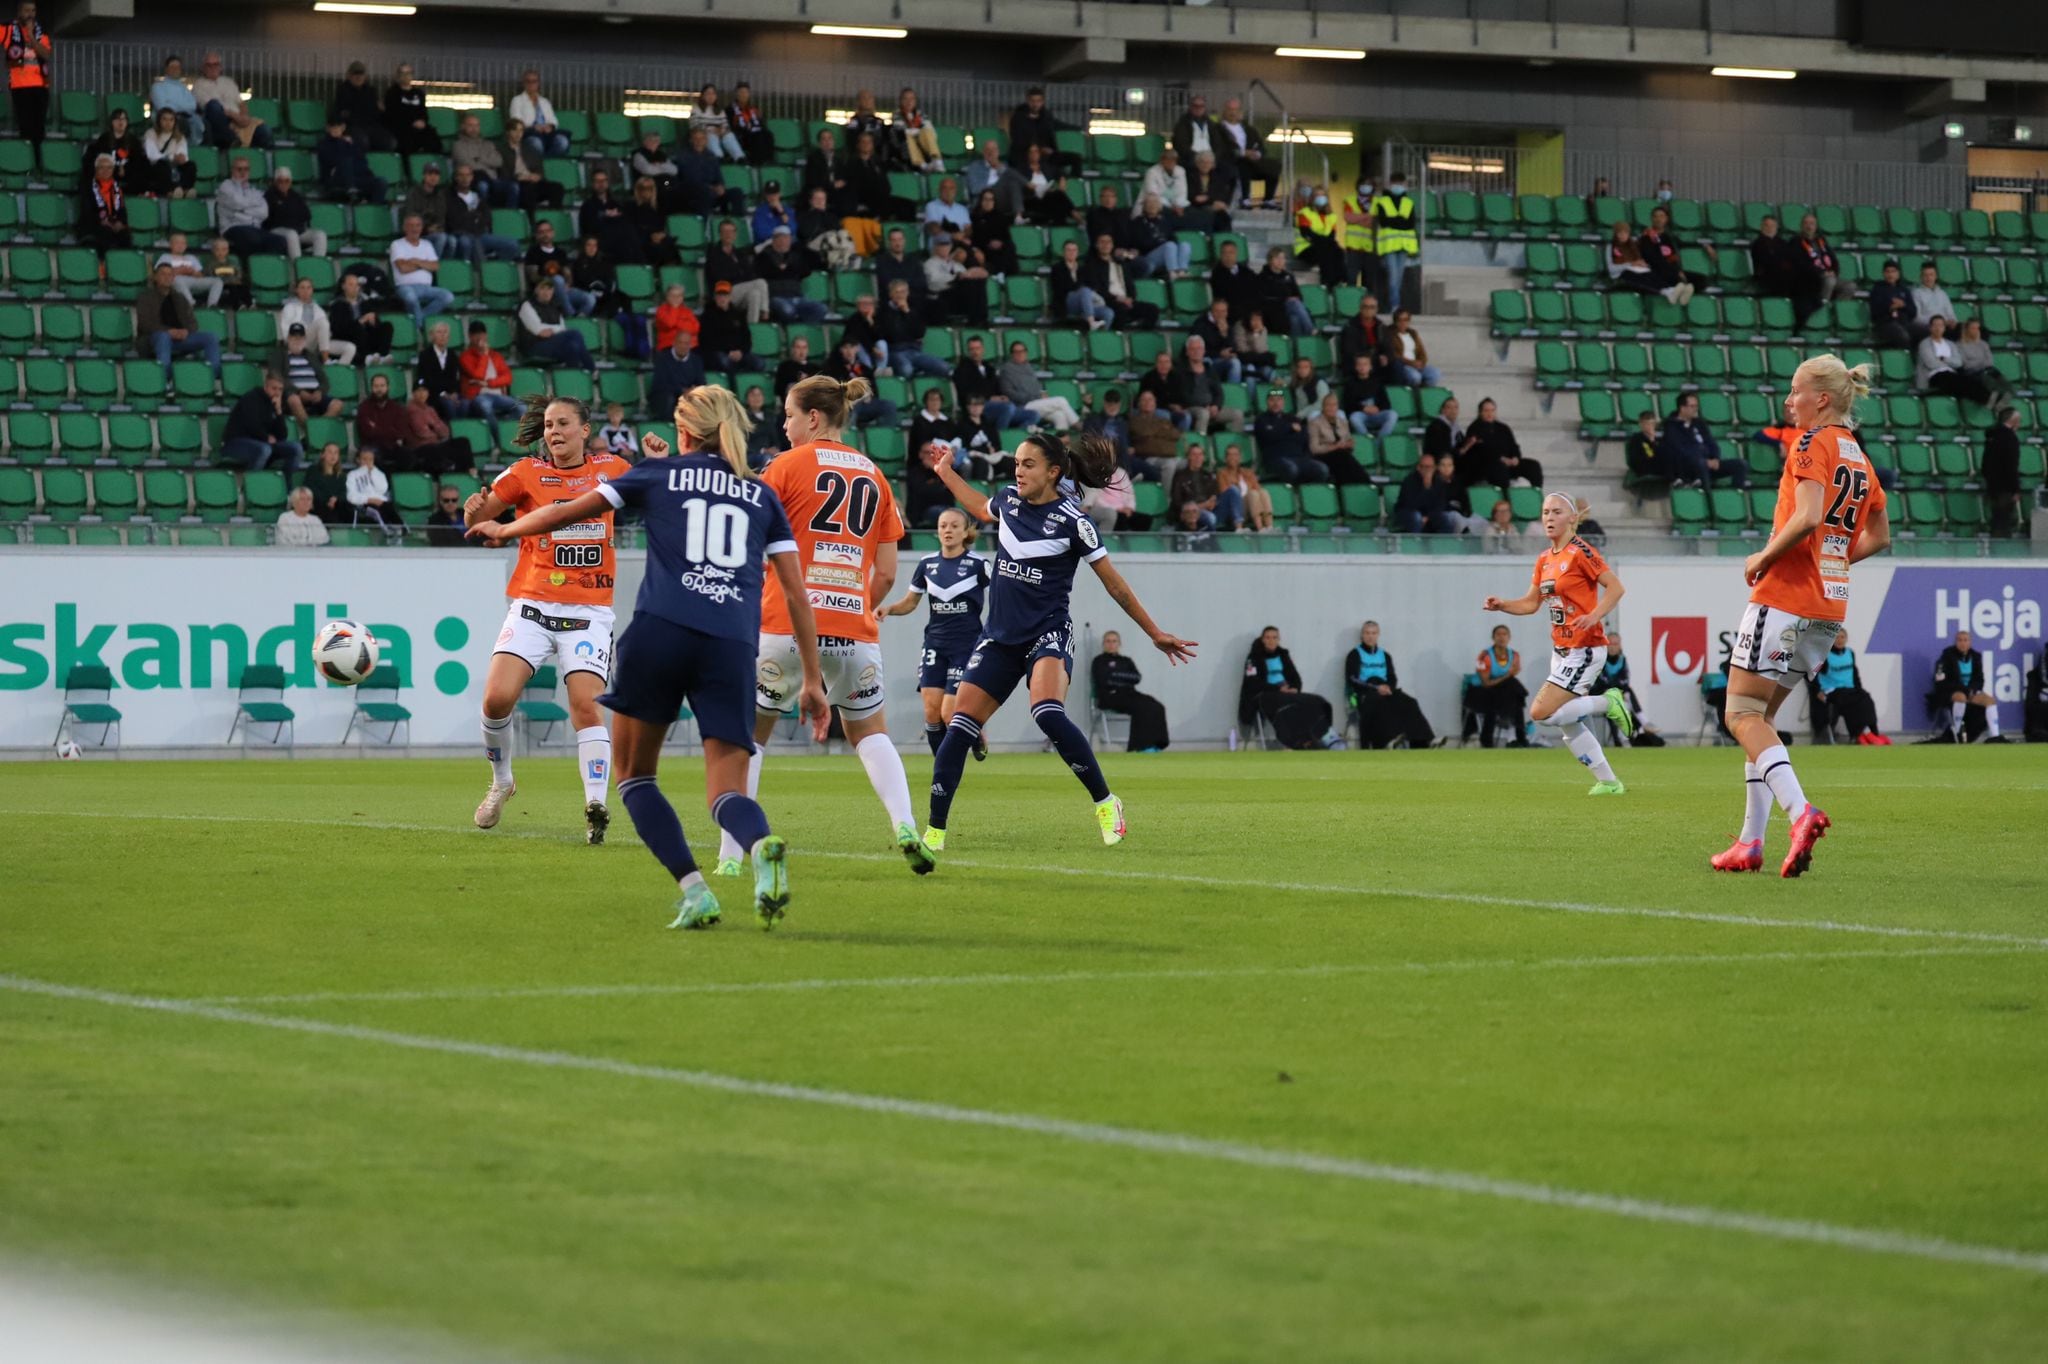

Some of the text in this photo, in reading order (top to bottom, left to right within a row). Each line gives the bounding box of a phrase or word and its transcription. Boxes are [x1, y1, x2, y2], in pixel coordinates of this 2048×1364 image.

[809, 470, 880, 539] 20
[1824, 464, 1869, 532] 25
[681, 498, 750, 568] 10
[816, 542, 862, 556] STARKA
[825, 595, 861, 610] NEAB
[1936, 585, 2041, 650] Heja
[1739, 633, 1753, 650] 25
[1561, 666, 1573, 678] 18
